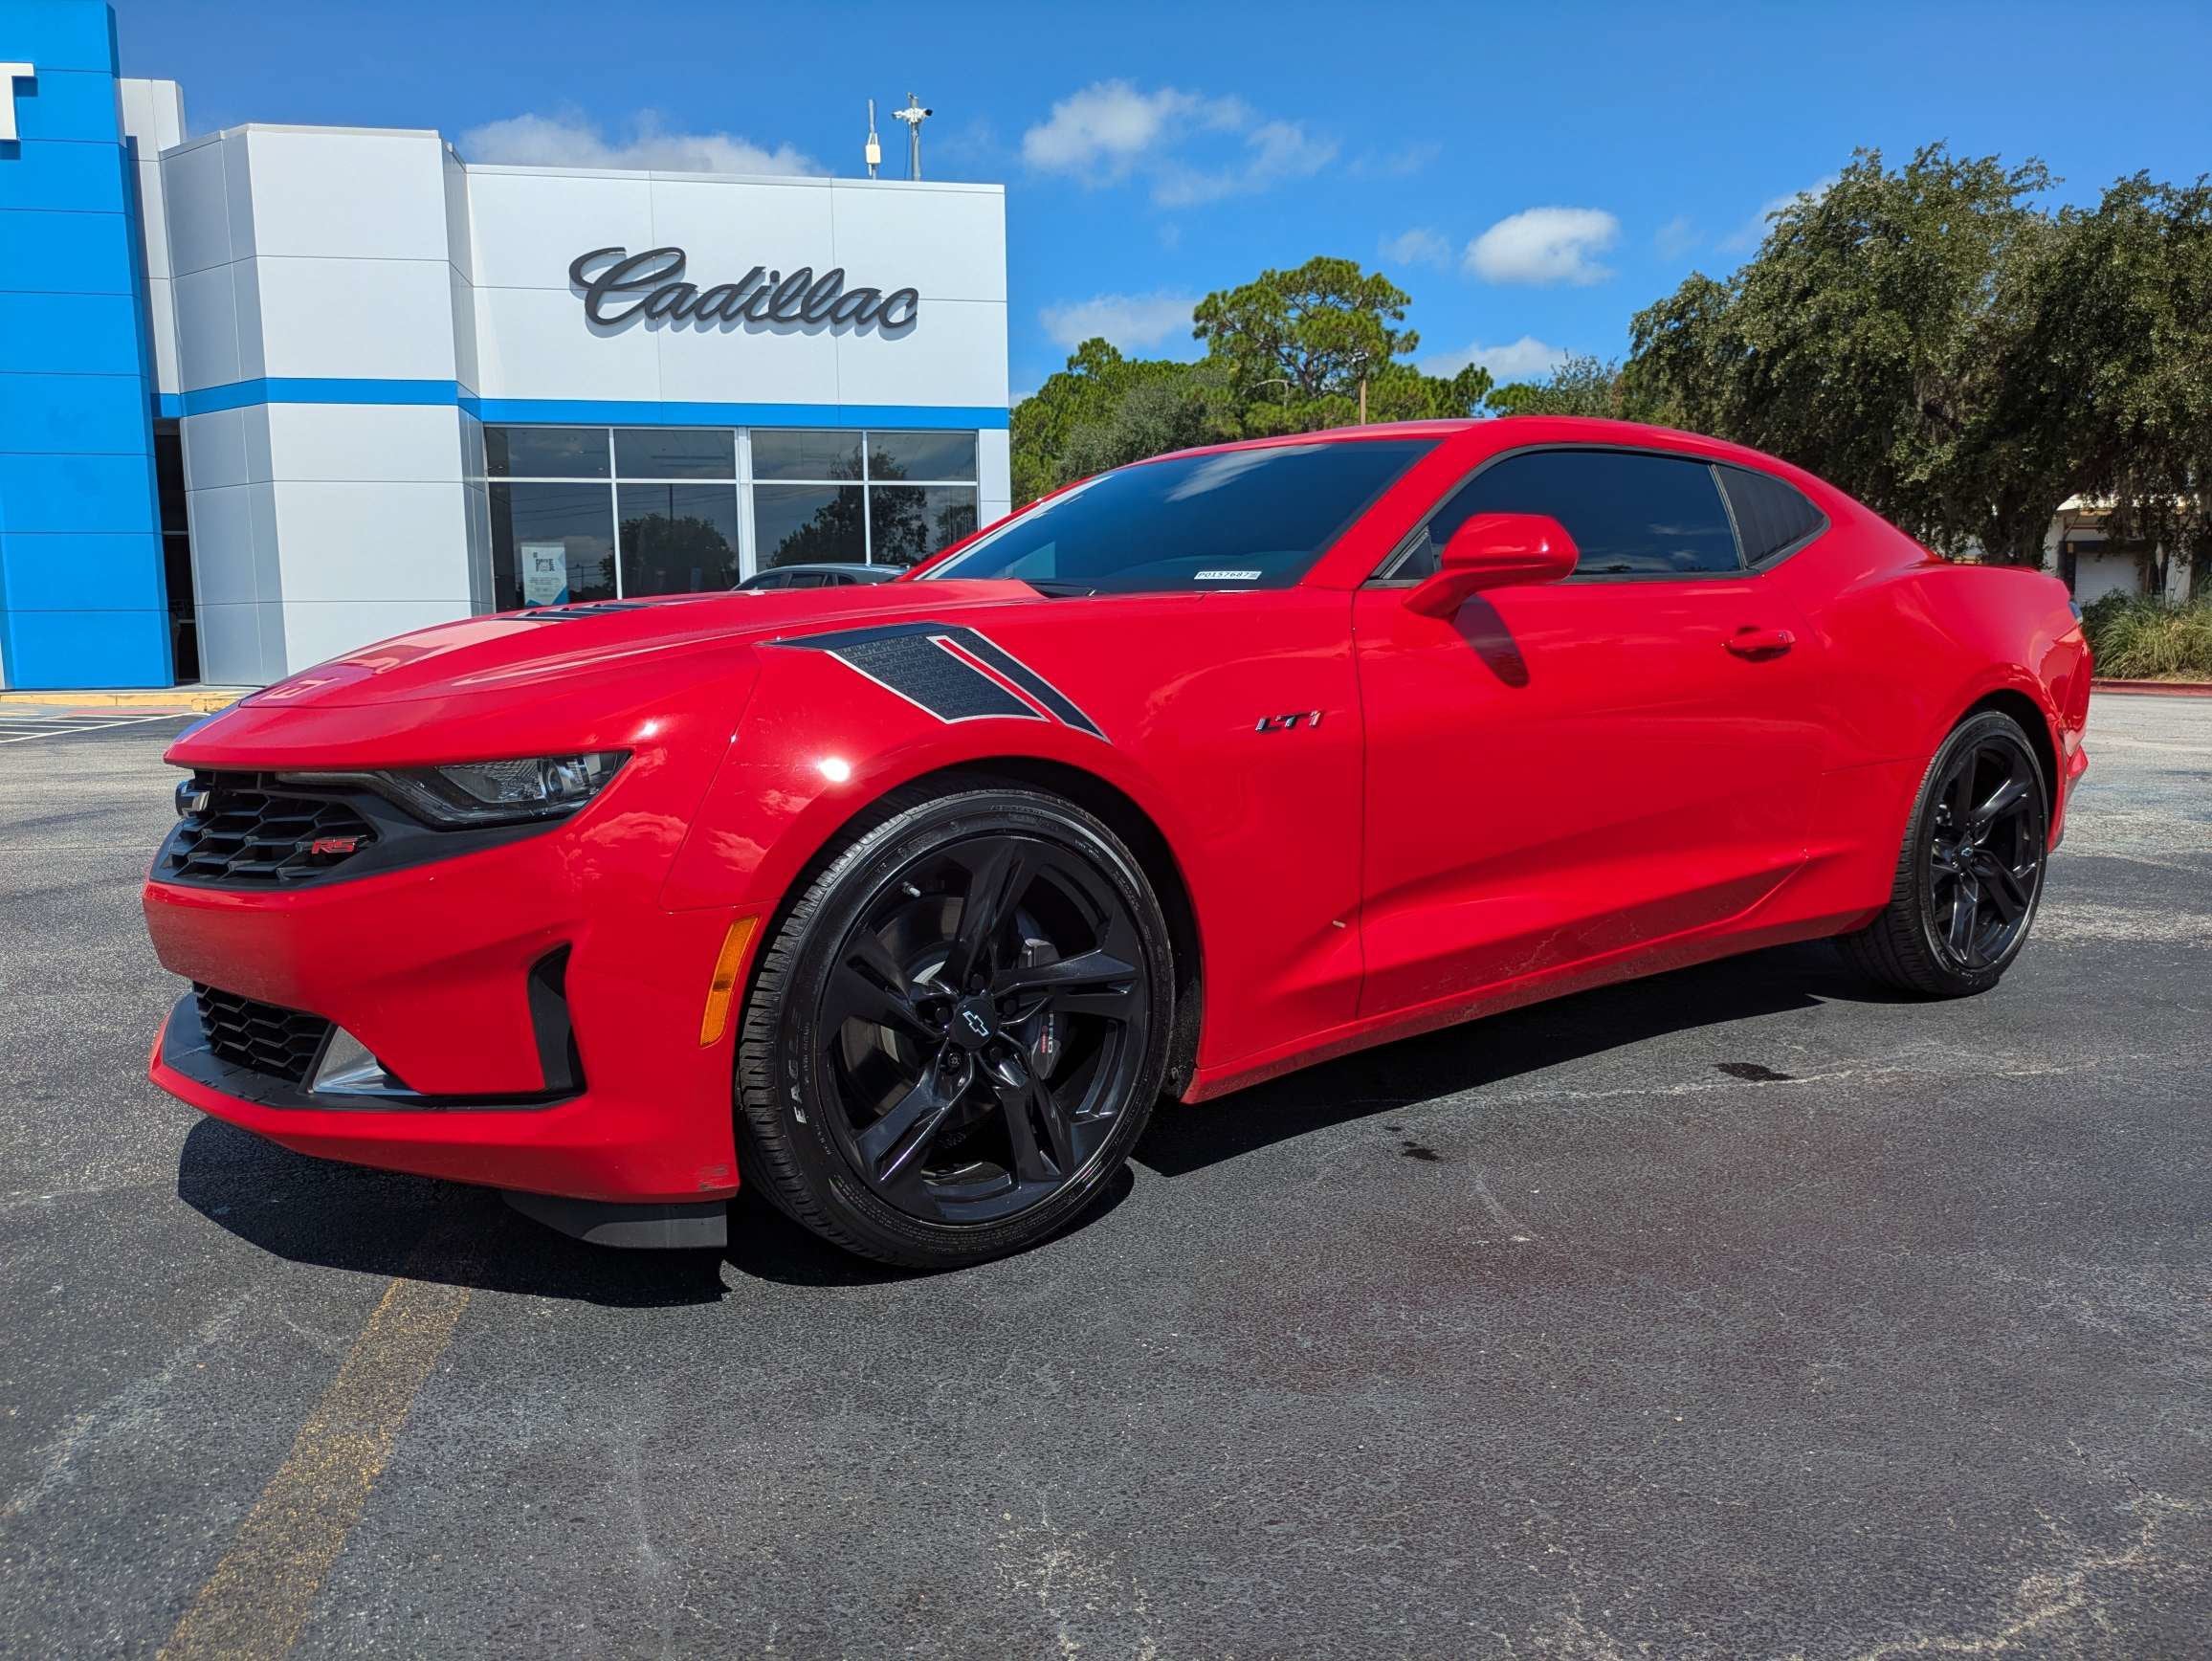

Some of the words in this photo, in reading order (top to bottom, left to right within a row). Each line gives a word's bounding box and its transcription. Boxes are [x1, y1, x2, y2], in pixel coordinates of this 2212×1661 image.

[569, 247, 918, 328] Cadillac
[1254, 710, 1322, 734] LT1
[312, 837, 359, 853] RS
